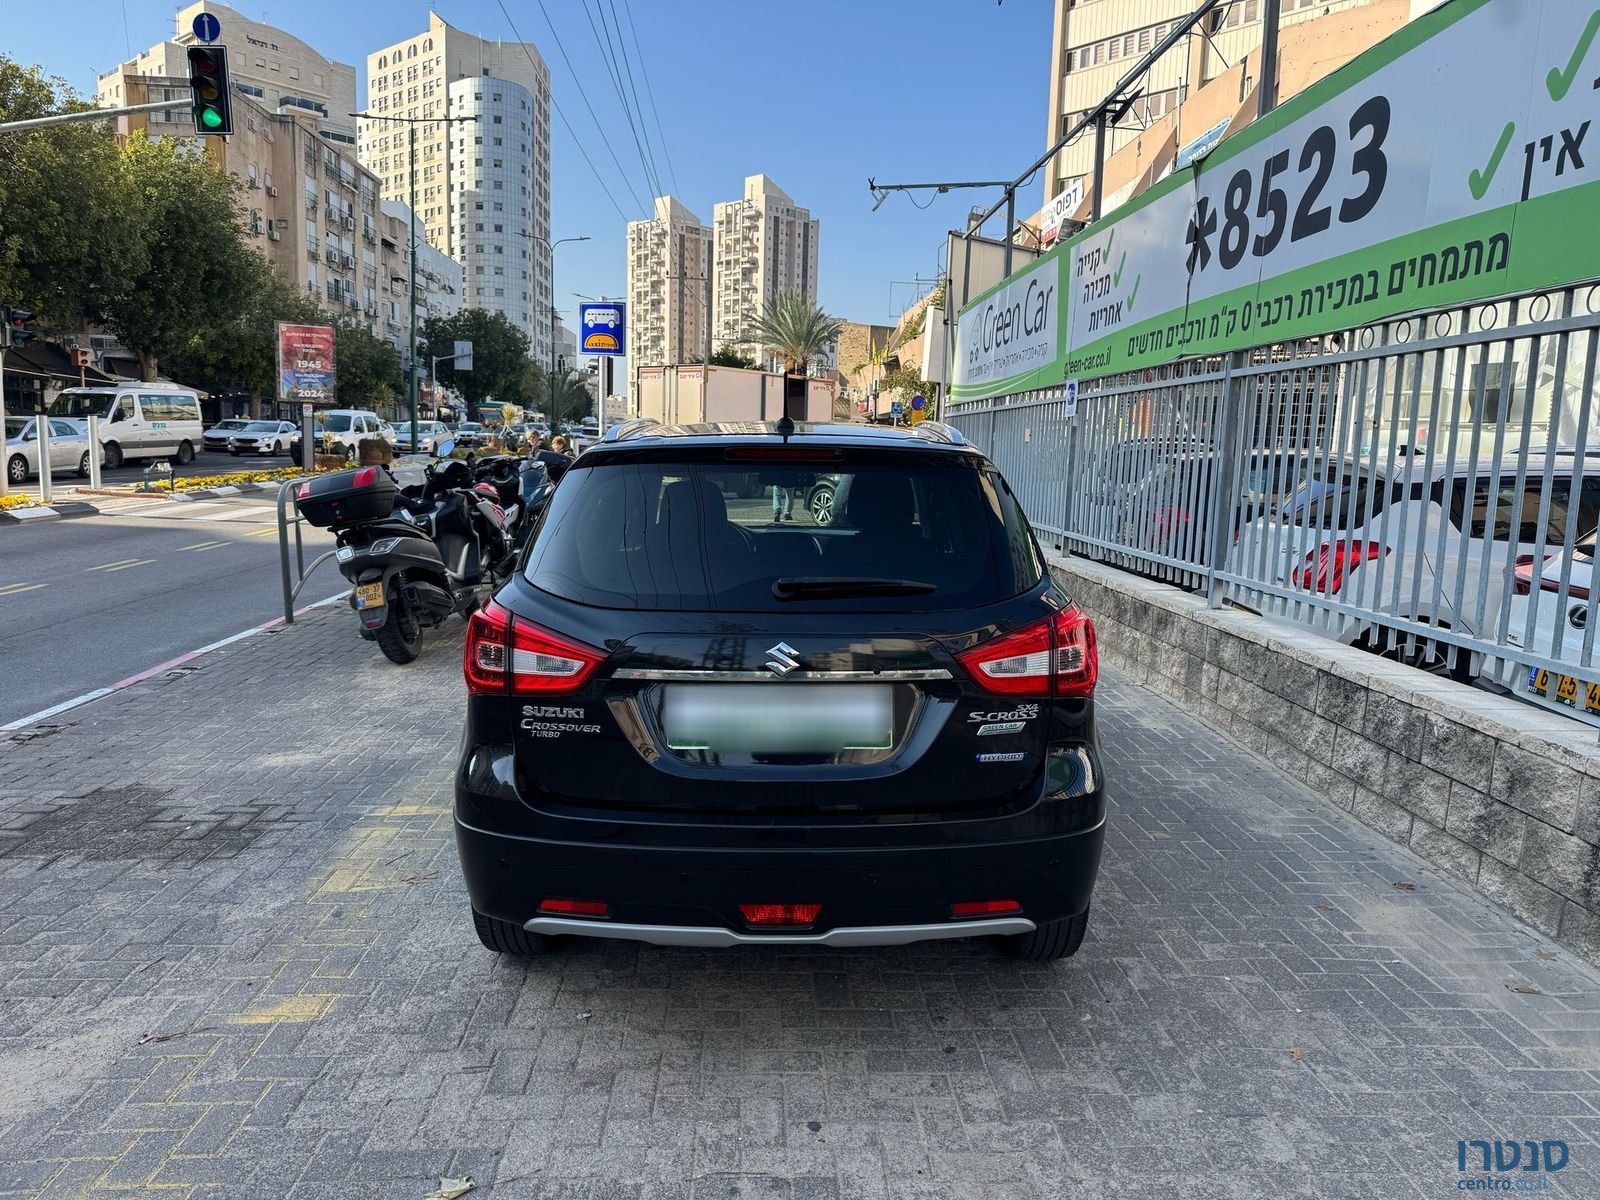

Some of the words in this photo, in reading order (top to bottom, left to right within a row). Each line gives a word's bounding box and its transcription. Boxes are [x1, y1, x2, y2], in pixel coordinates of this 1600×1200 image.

[1521, 119, 1592, 202] אין
[1056, 187, 1078, 216] דפוס
[1076, 247, 1102, 277] קנייה
[1387, 232, 1510, 296] מתמחים
[1083, 273, 1112, 305] מכירה
[1297, 269, 1379, 320] במכירת
[982, 304, 1021, 353] Green
[1024, 278, 1054, 337] Car
[1088, 300, 1123, 333] אחריות
[1256, 294, 1294, 328] רכבי
[1127, 329, 1164, 358] חדשים
[1165, 317, 1207, 349] ורכבים
[297, 360, 321, 368] 1945
[1063, 346, 1112, 380] green-car.co.il
[298, 389, 324, 398] 2024
[522, 705, 584, 718] SUZUKI
[531, 730, 560, 738] TURBO
